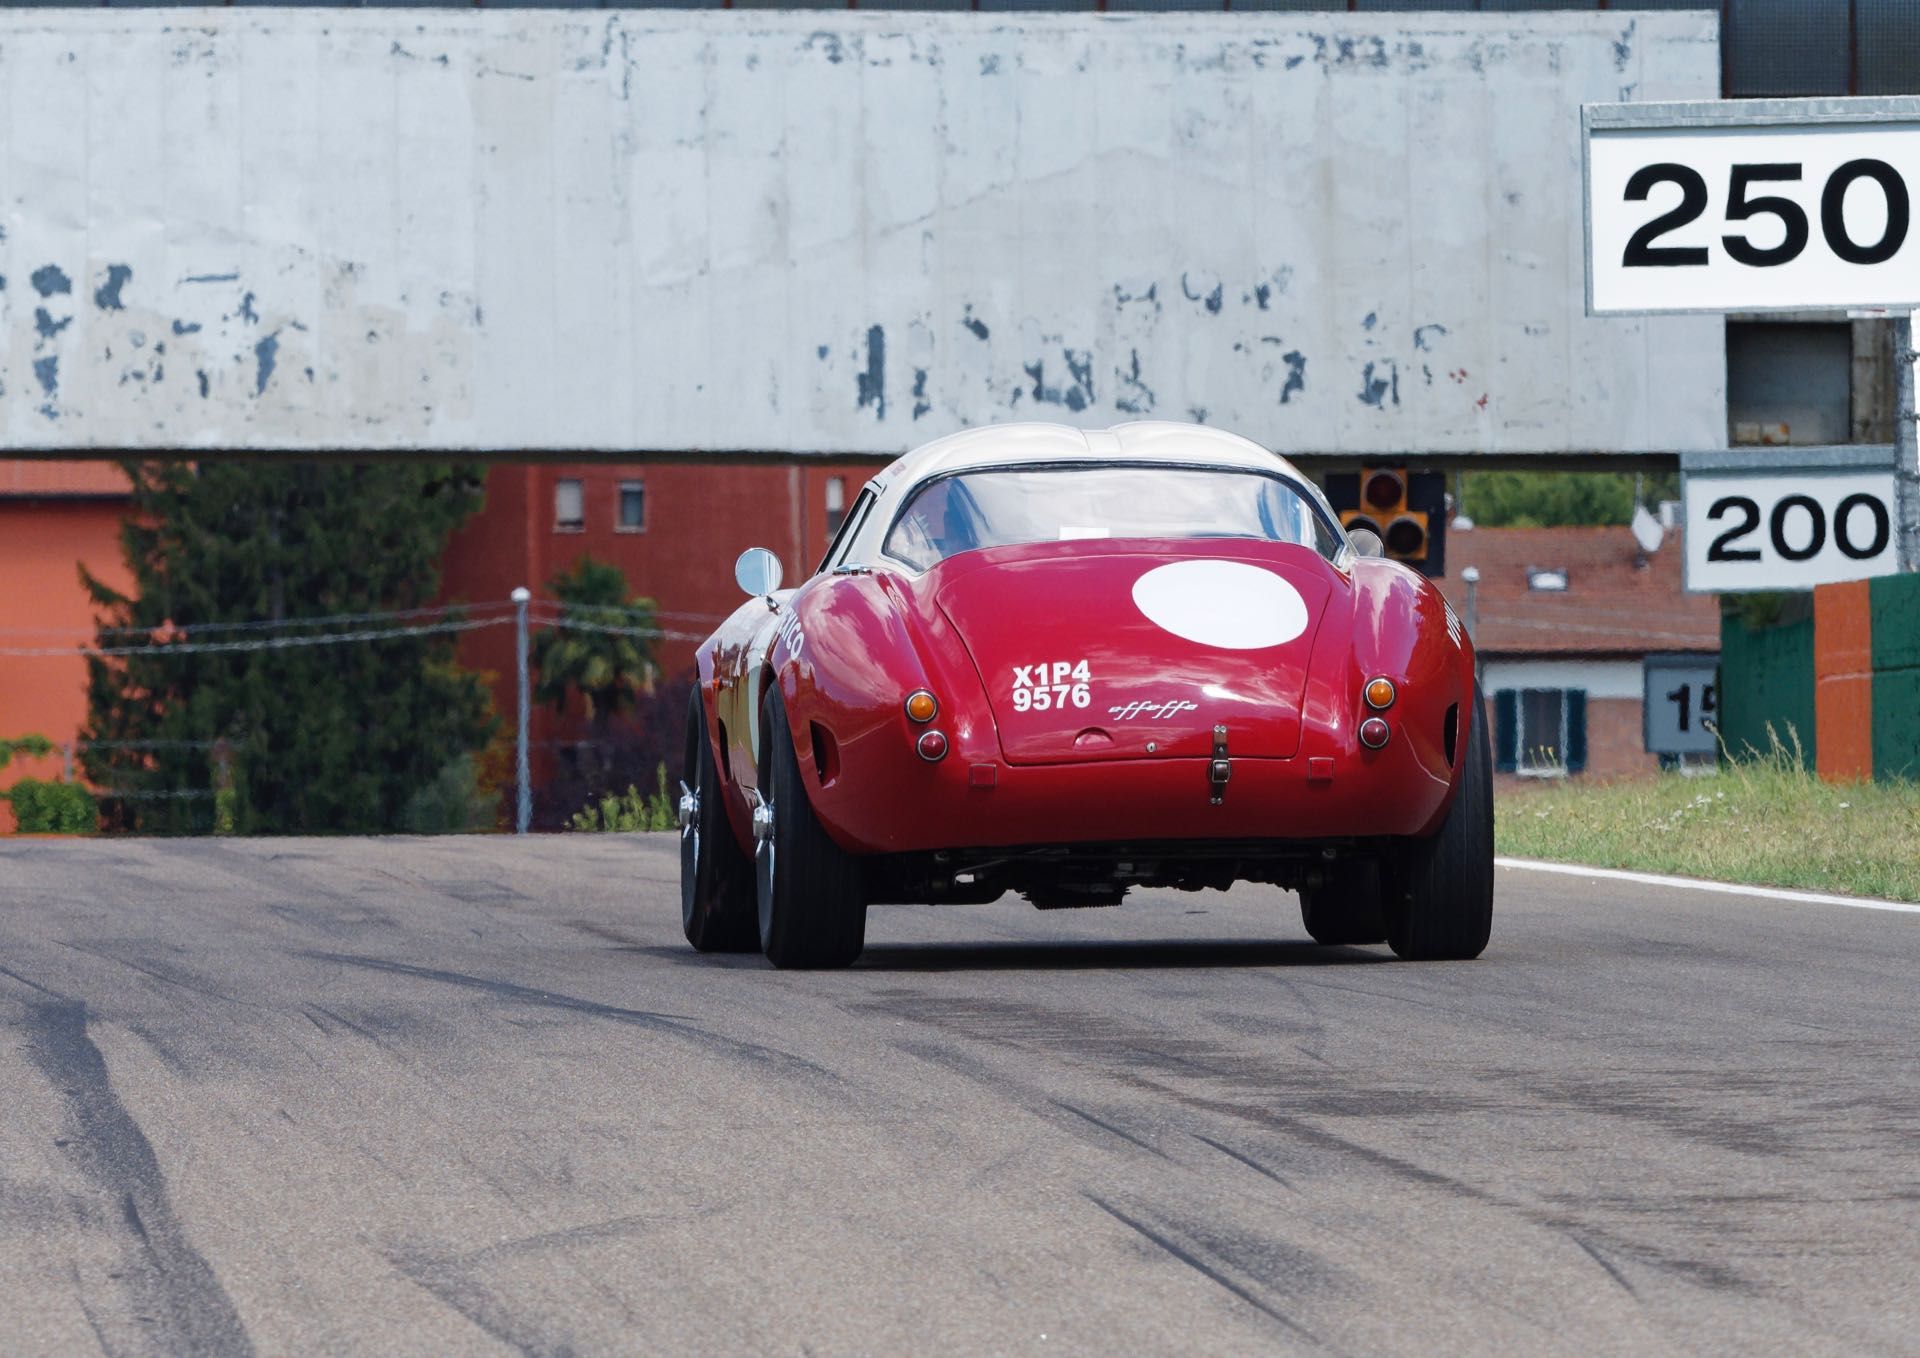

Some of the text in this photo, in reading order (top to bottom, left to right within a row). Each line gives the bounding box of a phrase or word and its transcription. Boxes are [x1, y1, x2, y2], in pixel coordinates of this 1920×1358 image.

[1622, 158, 1910, 268] 250
[1706, 493, 1890, 562] 200
[1012, 660, 1091, 688] X1P4
[1012, 683, 1091, 712] 9576
